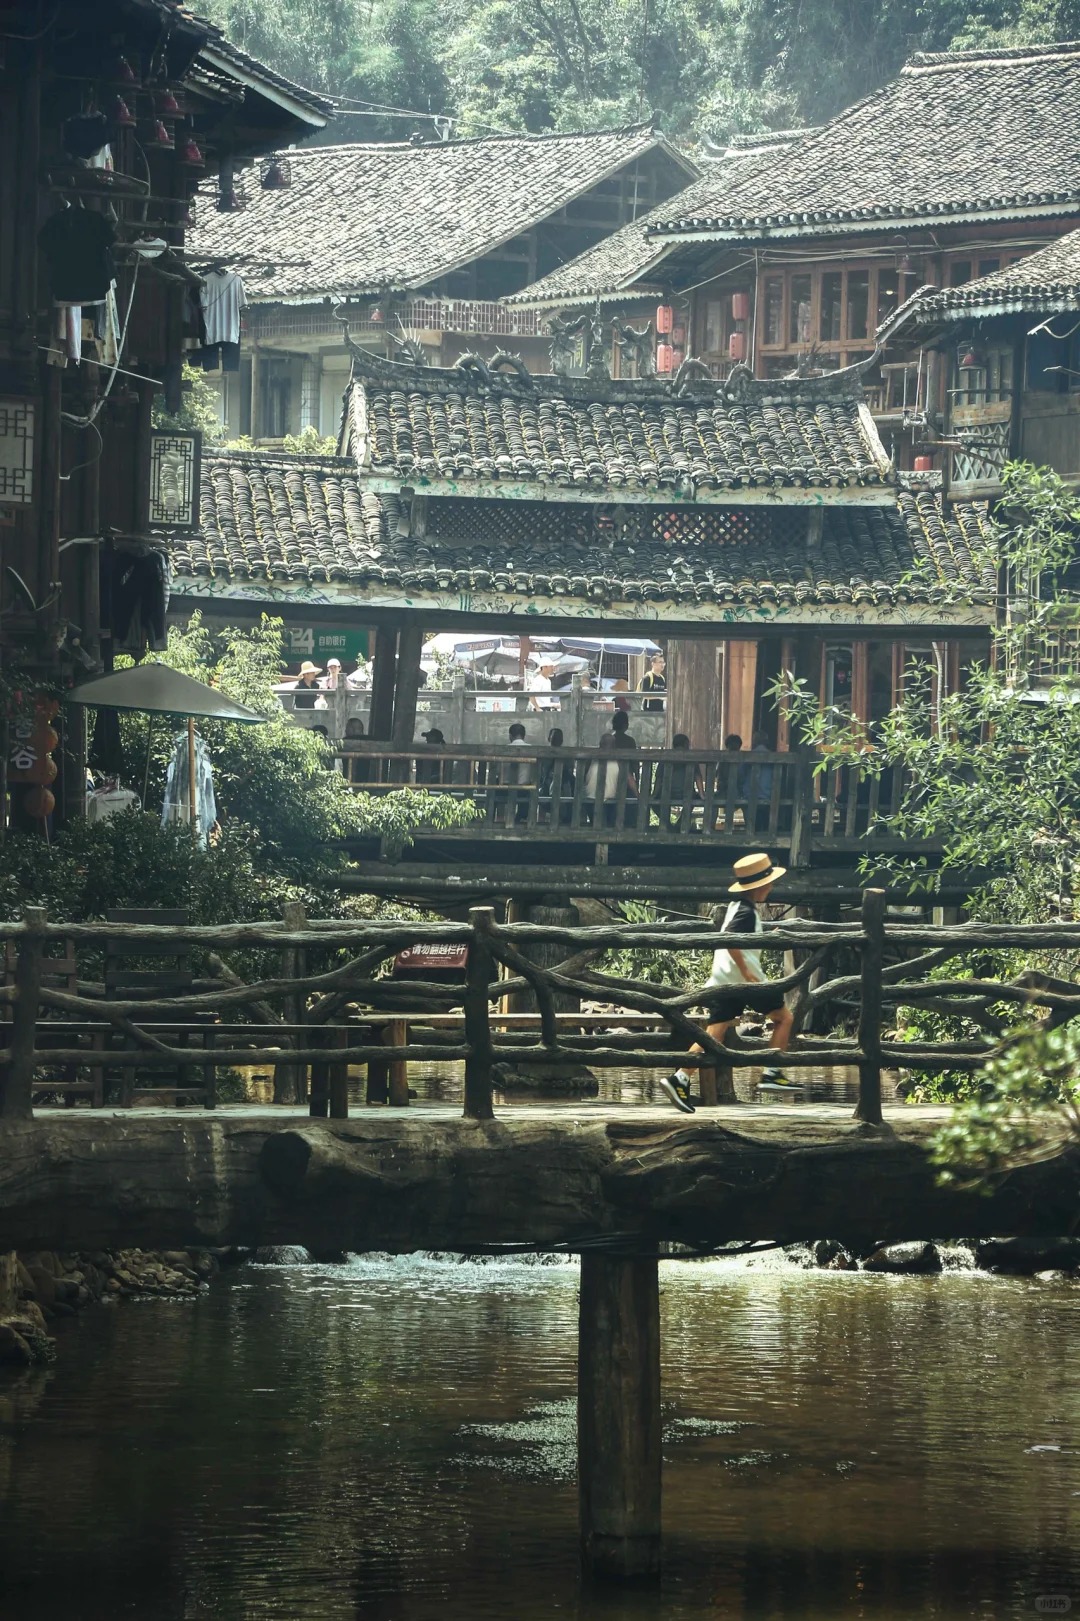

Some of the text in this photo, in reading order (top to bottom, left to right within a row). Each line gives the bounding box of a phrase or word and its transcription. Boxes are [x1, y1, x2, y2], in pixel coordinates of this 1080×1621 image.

[291, 628, 315, 655] 24
[318, 636, 346, 646] 自助银行
[412, 943, 467, 955] 请勿翻越栏杆
